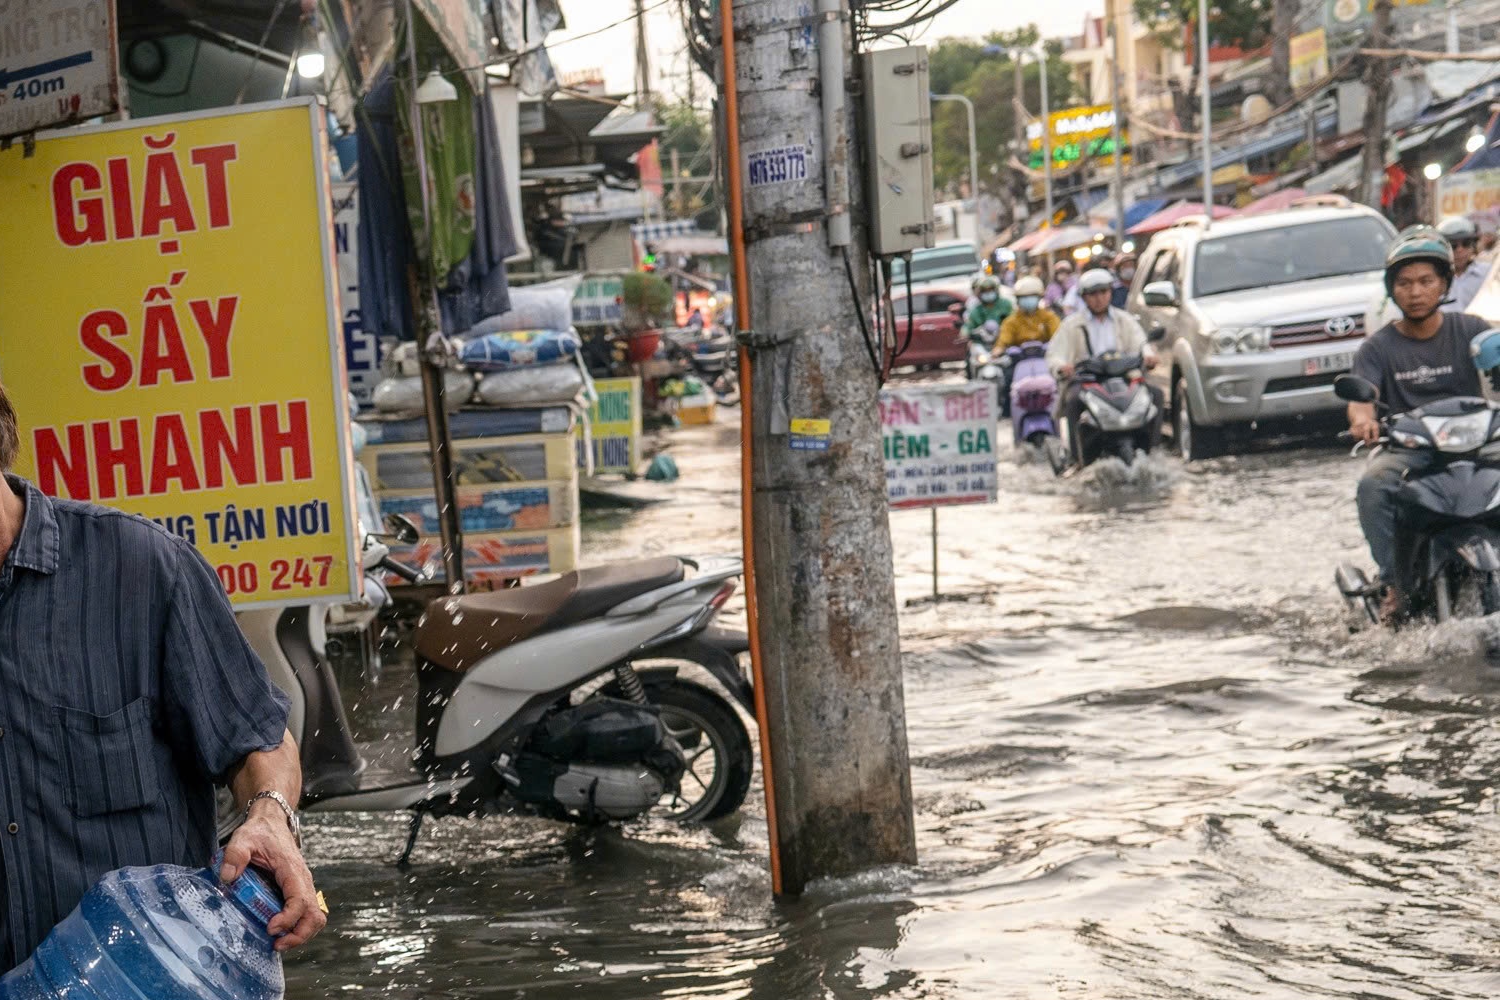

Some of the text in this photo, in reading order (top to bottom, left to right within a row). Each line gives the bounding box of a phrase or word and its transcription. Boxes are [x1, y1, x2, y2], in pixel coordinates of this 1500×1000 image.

[13, 75, 65, 101] 40m
[52, 132, 238, 254] GIẶT
[79, 270, 239, 391] SẤY
[33, 400, 313, 501] NHANH
[957, 428, 992, 455] GA
[204, 504, 266, 549] TẬN
[275, 499, 331, 538] NƠI
[270, 555, 333, 592] 247
